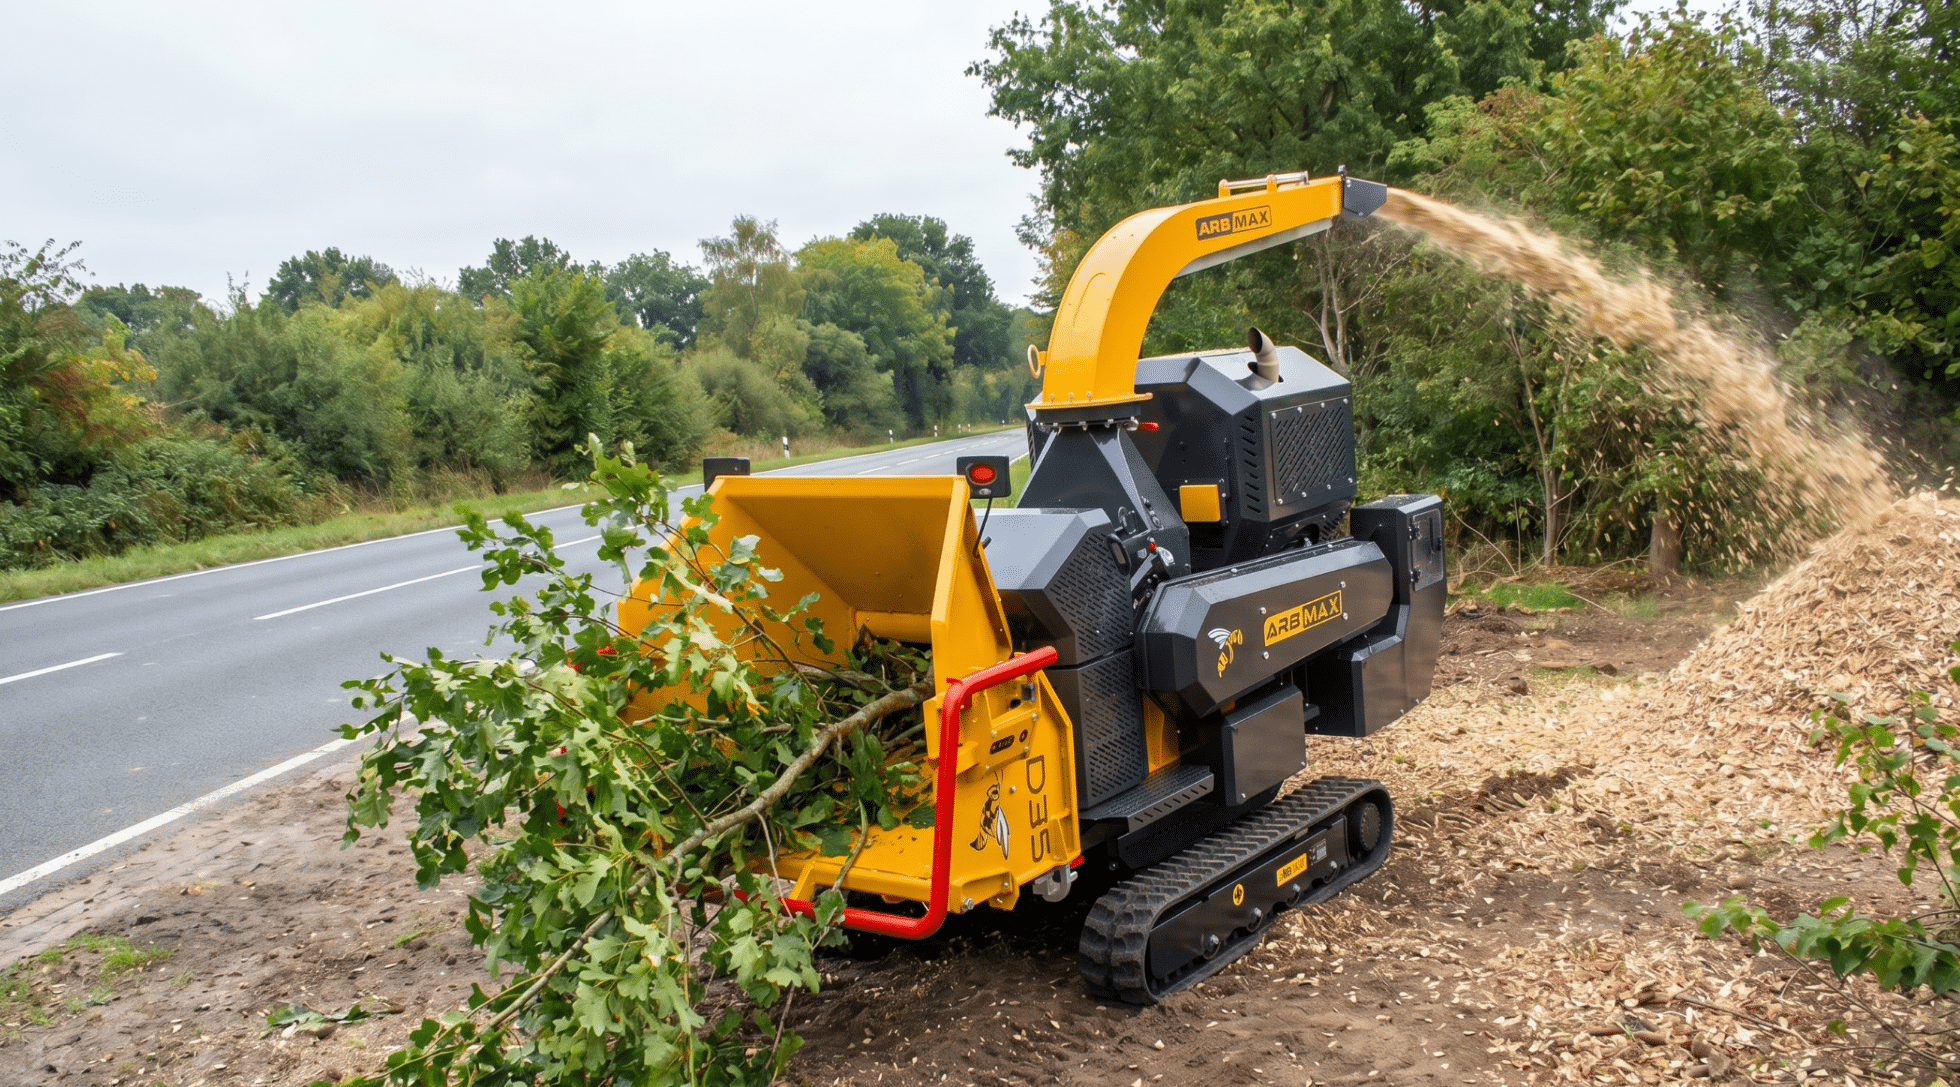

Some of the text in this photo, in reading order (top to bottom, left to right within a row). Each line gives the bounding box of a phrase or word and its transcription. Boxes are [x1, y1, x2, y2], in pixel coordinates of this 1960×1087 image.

[1199, 211, 1269, 236] ARB MAX
[1266, 596, 1340, 640] ARB MAX
[1026, 755, 1051, 862] D35
